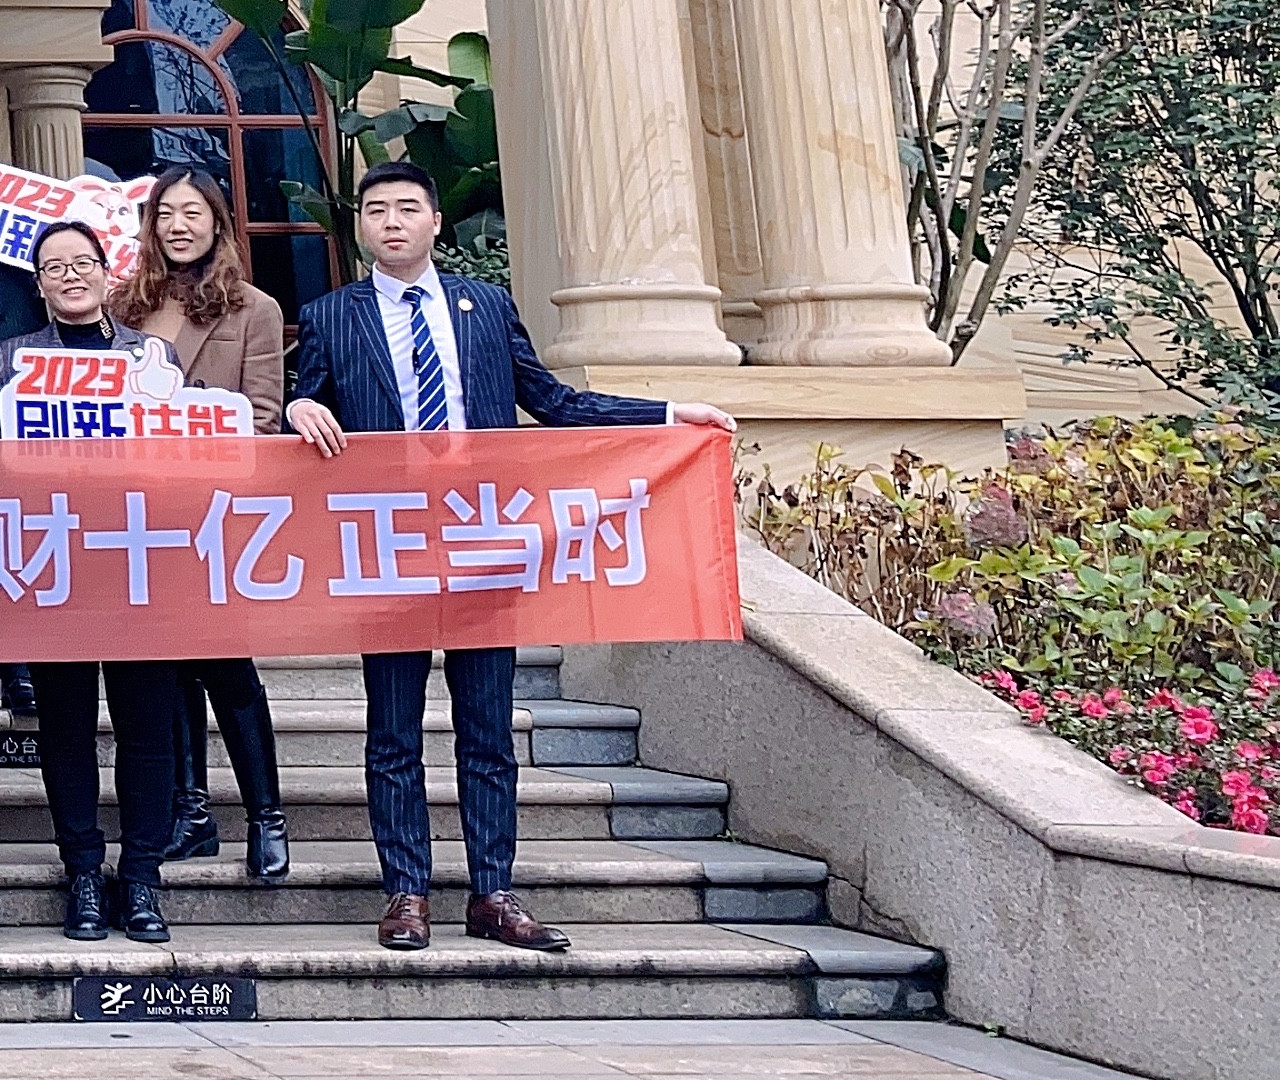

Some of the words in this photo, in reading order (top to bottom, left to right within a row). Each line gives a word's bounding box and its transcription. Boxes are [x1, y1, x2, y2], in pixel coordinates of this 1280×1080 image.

[16, 355, 128, 397] 2023
[328, 477, 650, 595] 正当时
[142, 983, 233, 1005] 小心台阶
[146, 1006, 172, 1016] MIND
[175, 1006, 195, 1016] THE
[197, 1006, 229, 1016] STEPS
